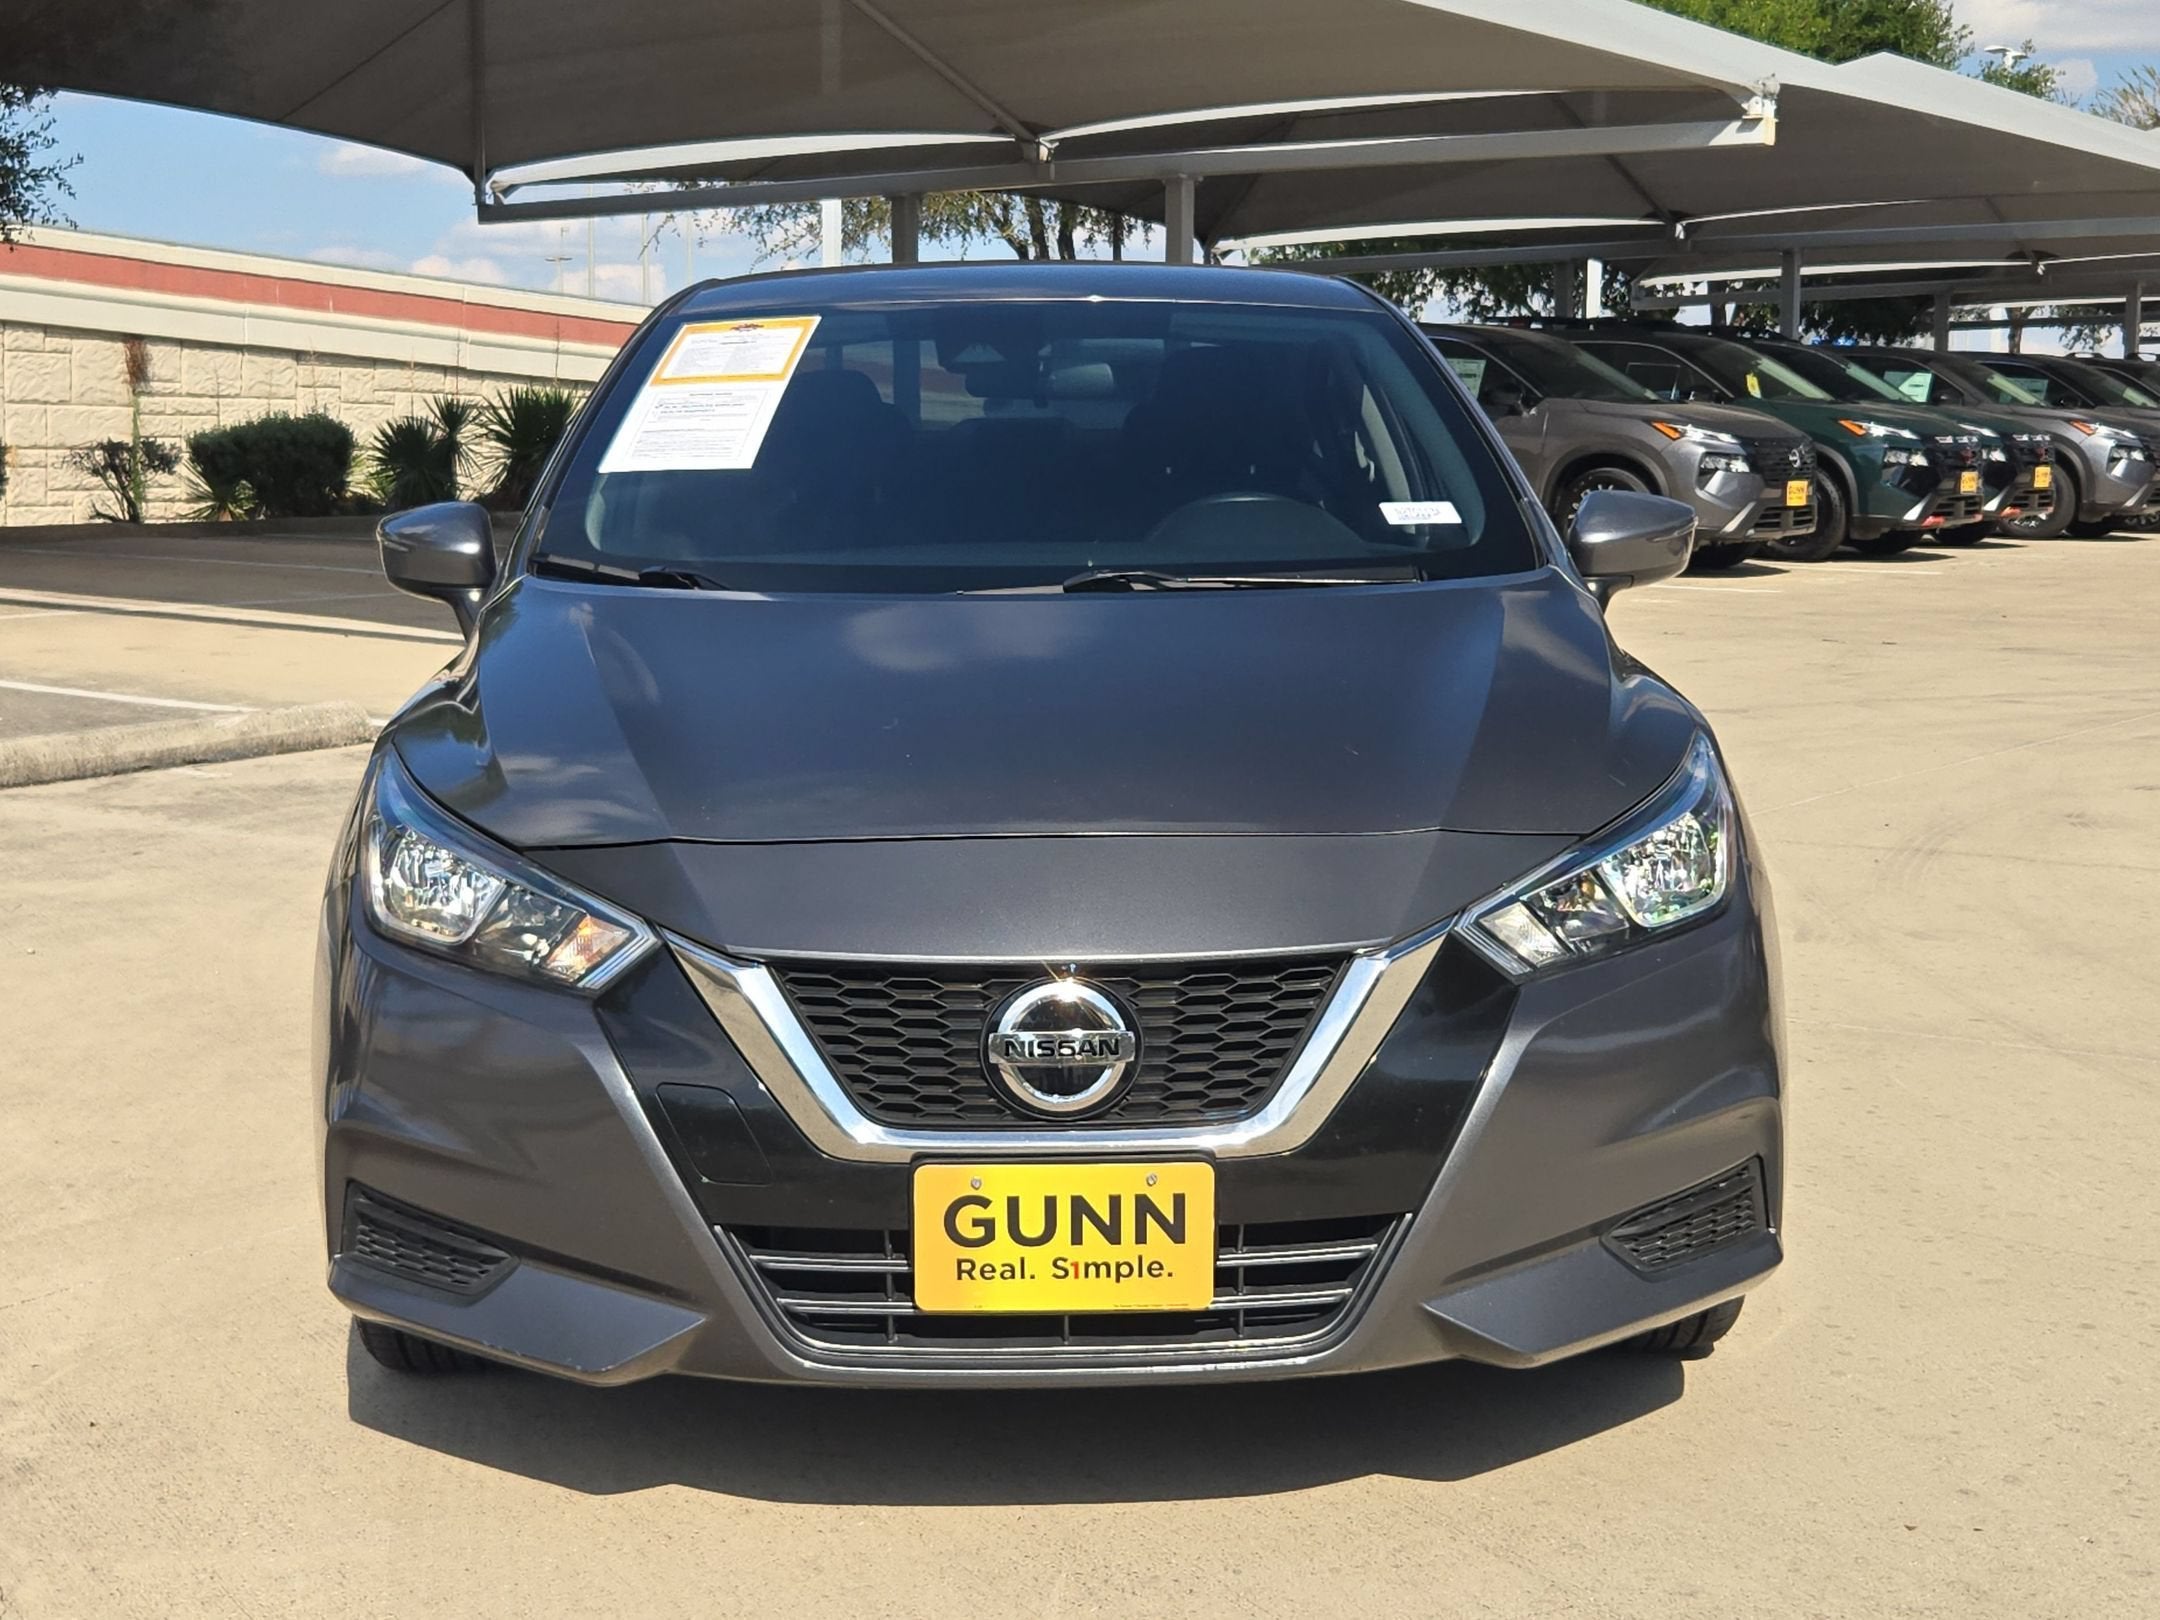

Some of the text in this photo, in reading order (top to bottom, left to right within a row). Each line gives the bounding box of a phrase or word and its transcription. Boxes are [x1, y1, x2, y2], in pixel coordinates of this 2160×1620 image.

[1004, 1038, 1119, 1057] NISSAN
[943, 1193, 1185, 1248] GUNN
[956, 1257, 1035, 1281] Real.
